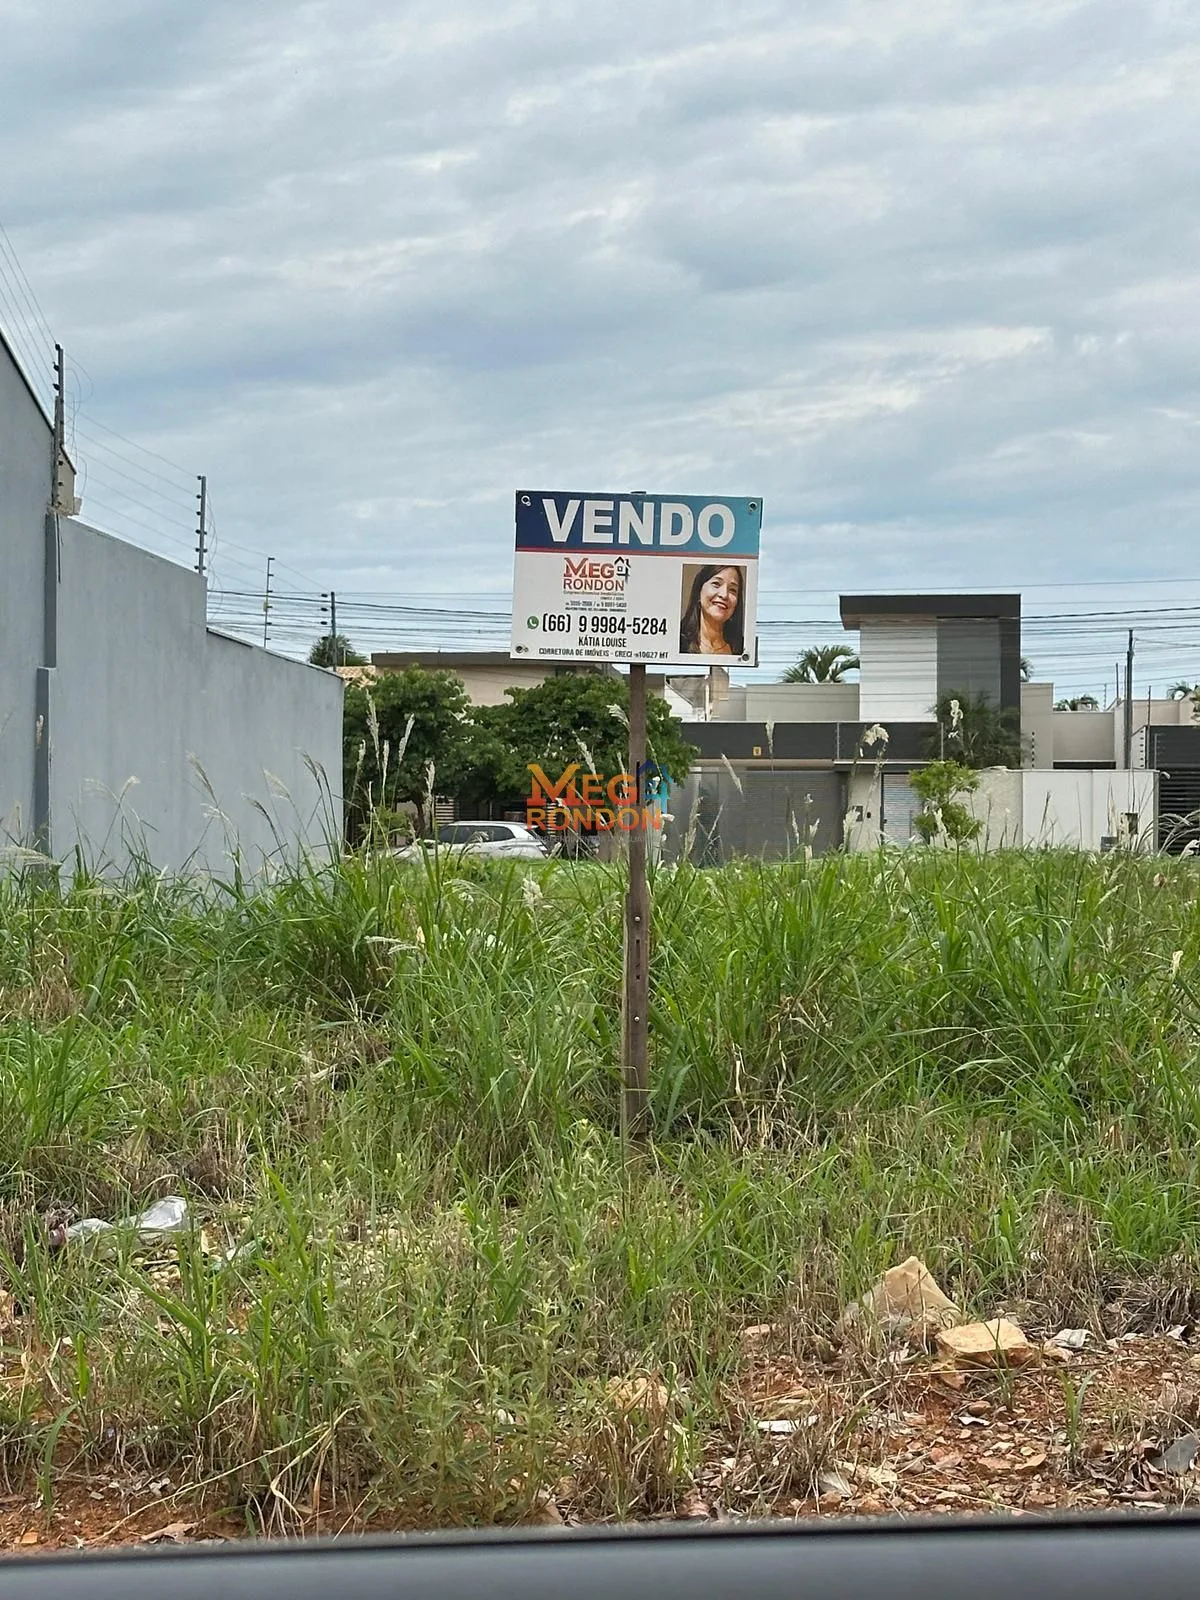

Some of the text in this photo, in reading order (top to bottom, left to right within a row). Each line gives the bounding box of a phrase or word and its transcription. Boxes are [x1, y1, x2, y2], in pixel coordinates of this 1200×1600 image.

[542, 498, 736, 548] VENDO
[563, 578, 624, 591] RONDON
[542, 613, 668, 635] (66) 9 9984-5284
[578, 635, 627, 648] KÁTIA LOUISE
[539, 647, 574, 656] CORRETORA
[575, 648, 584, 656] DE
[584, 648, 609, 657] IMÓVEIS
[614, 650, 633, 658] CRECI
